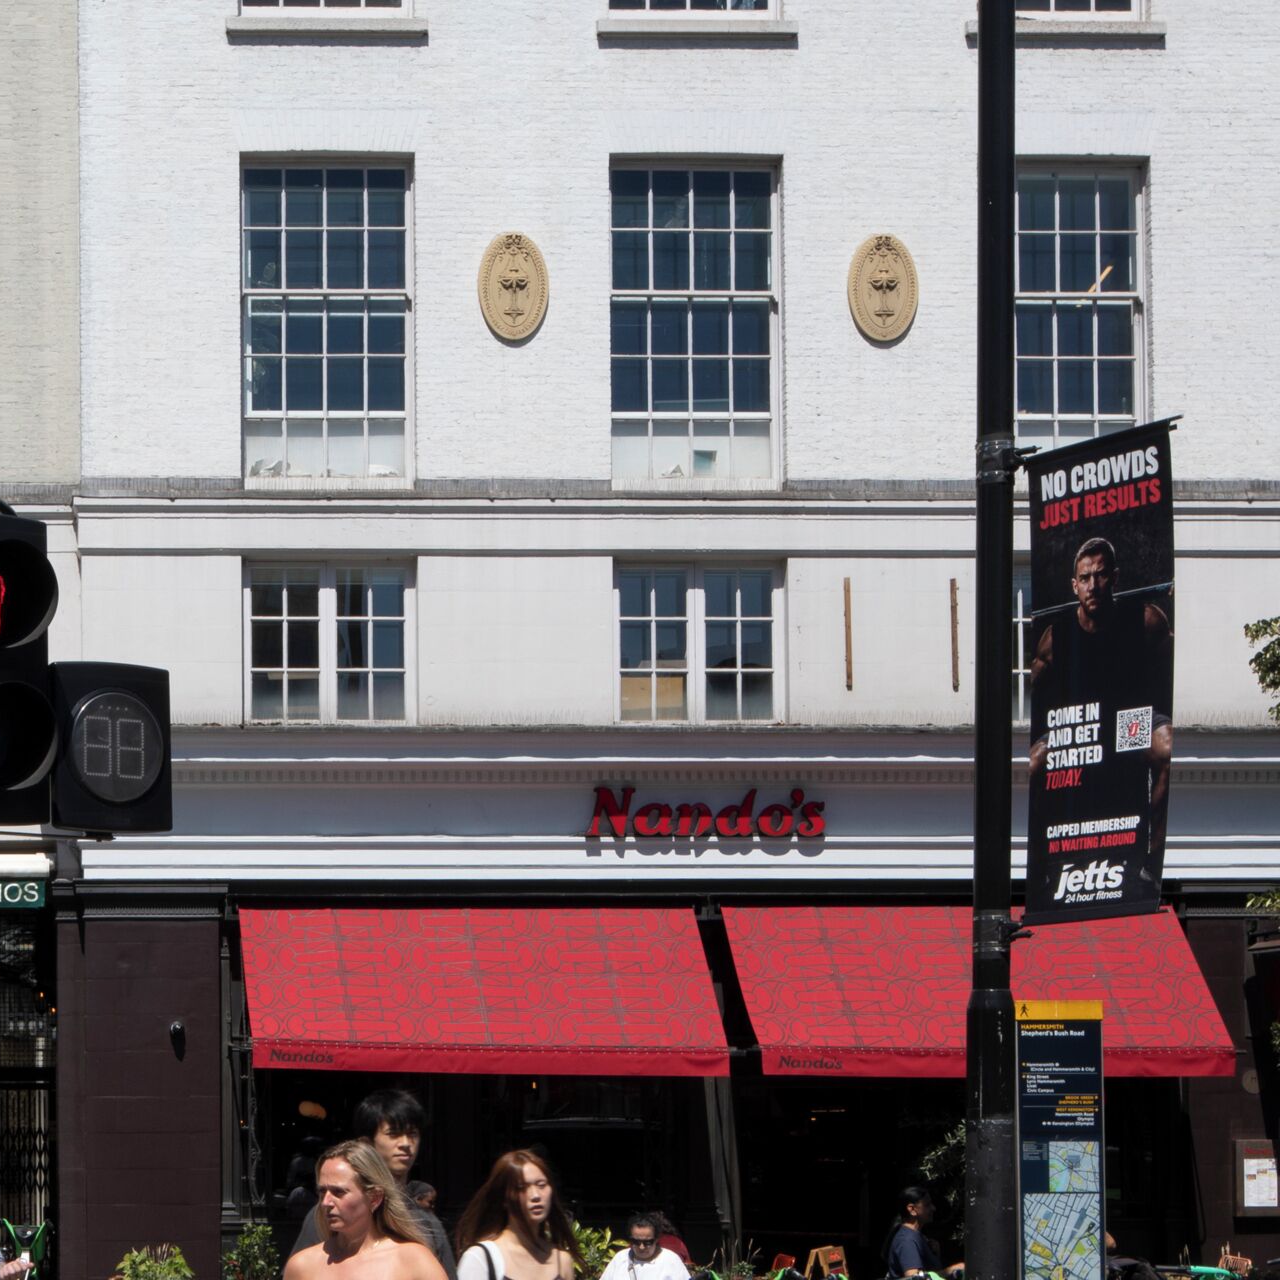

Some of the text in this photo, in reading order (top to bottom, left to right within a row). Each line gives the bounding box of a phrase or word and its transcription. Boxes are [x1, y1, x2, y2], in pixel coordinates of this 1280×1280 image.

[1040, 446, 1160, 502] NO CROWDS
[1040, 478, 1161, 530] JUST RESULTS
[1047, 702, 1100, 728] COME IN
[1047, 723, 1101, 748] AND GET
[1046, 745, 1103, 770] STARTED
[1046, 769, 1082, 790] TODAY.
[587, 787, 826, 837] Nando's
[1047, 815, 1140, 839] CAPPED MEMBERSHIP
[1049, 831, 1136, 854] NO WAITING AROUND
[1054, 860, 1124, 901] jetts
[1065, 889, 1122, 904] 24 hour fitness
[270, 1049, 334, 1064] Nando's
[779, 1055, 843, 1070] Nando's
